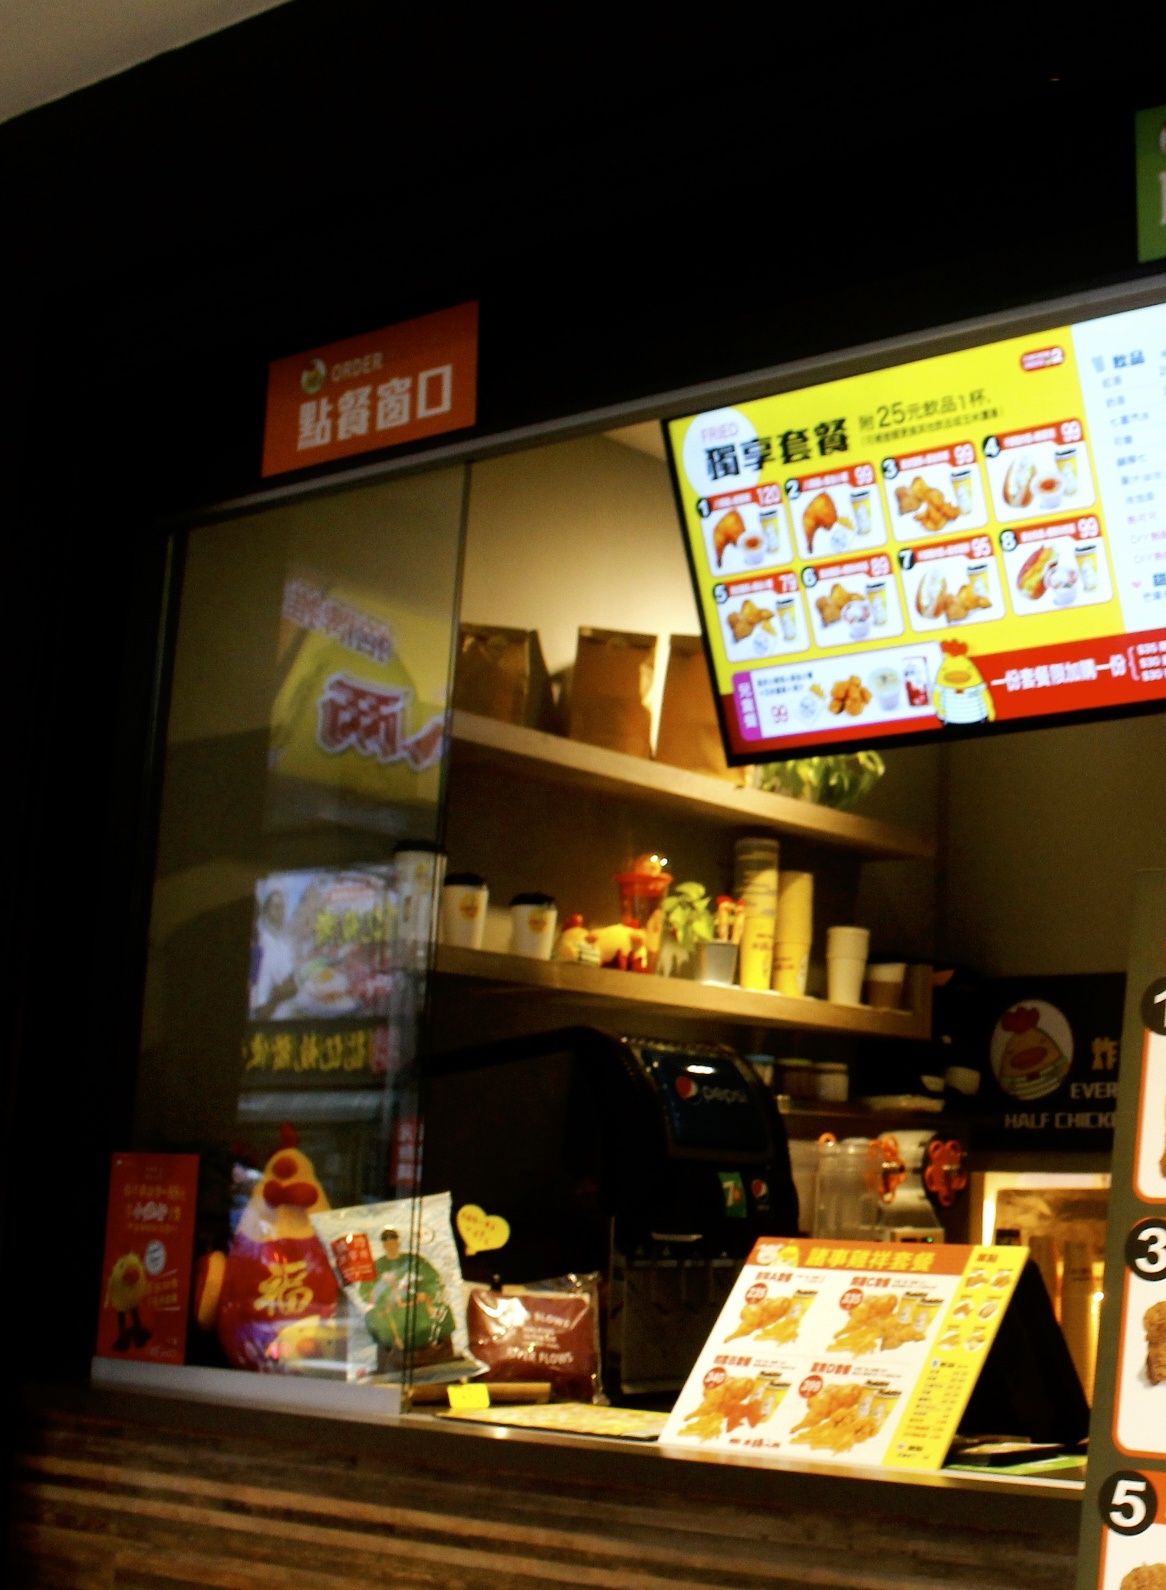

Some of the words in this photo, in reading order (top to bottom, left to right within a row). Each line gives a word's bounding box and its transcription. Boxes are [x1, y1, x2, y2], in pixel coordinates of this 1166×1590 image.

[332, 352, 383, 382] ORDER
[298, 365, 452, 450] 點餐窗口
[1061, 420, 1082, 443] 99
[706, 418, 848, 481] 獨享套餐
[954, 443, 975, 465] 99
[985, 437, 1000, 457] 4
[854, 464, 875, 486] 99
[884, 459, 898, 479] 3
[757, 484, 782, 505] 120
[787, 480, 800, 500] 2
[1078, 517, 1099, 538] 99
[1002, 531, 1018, 552] 8
[901, 551, 914, 570] 7
[716, 585, 728, 603] 5
[1004, 1112, 1049, 1129] HALF
[256, 1259, 313, 1316] 福
[1109, 1479, 1148, 1528] 5
